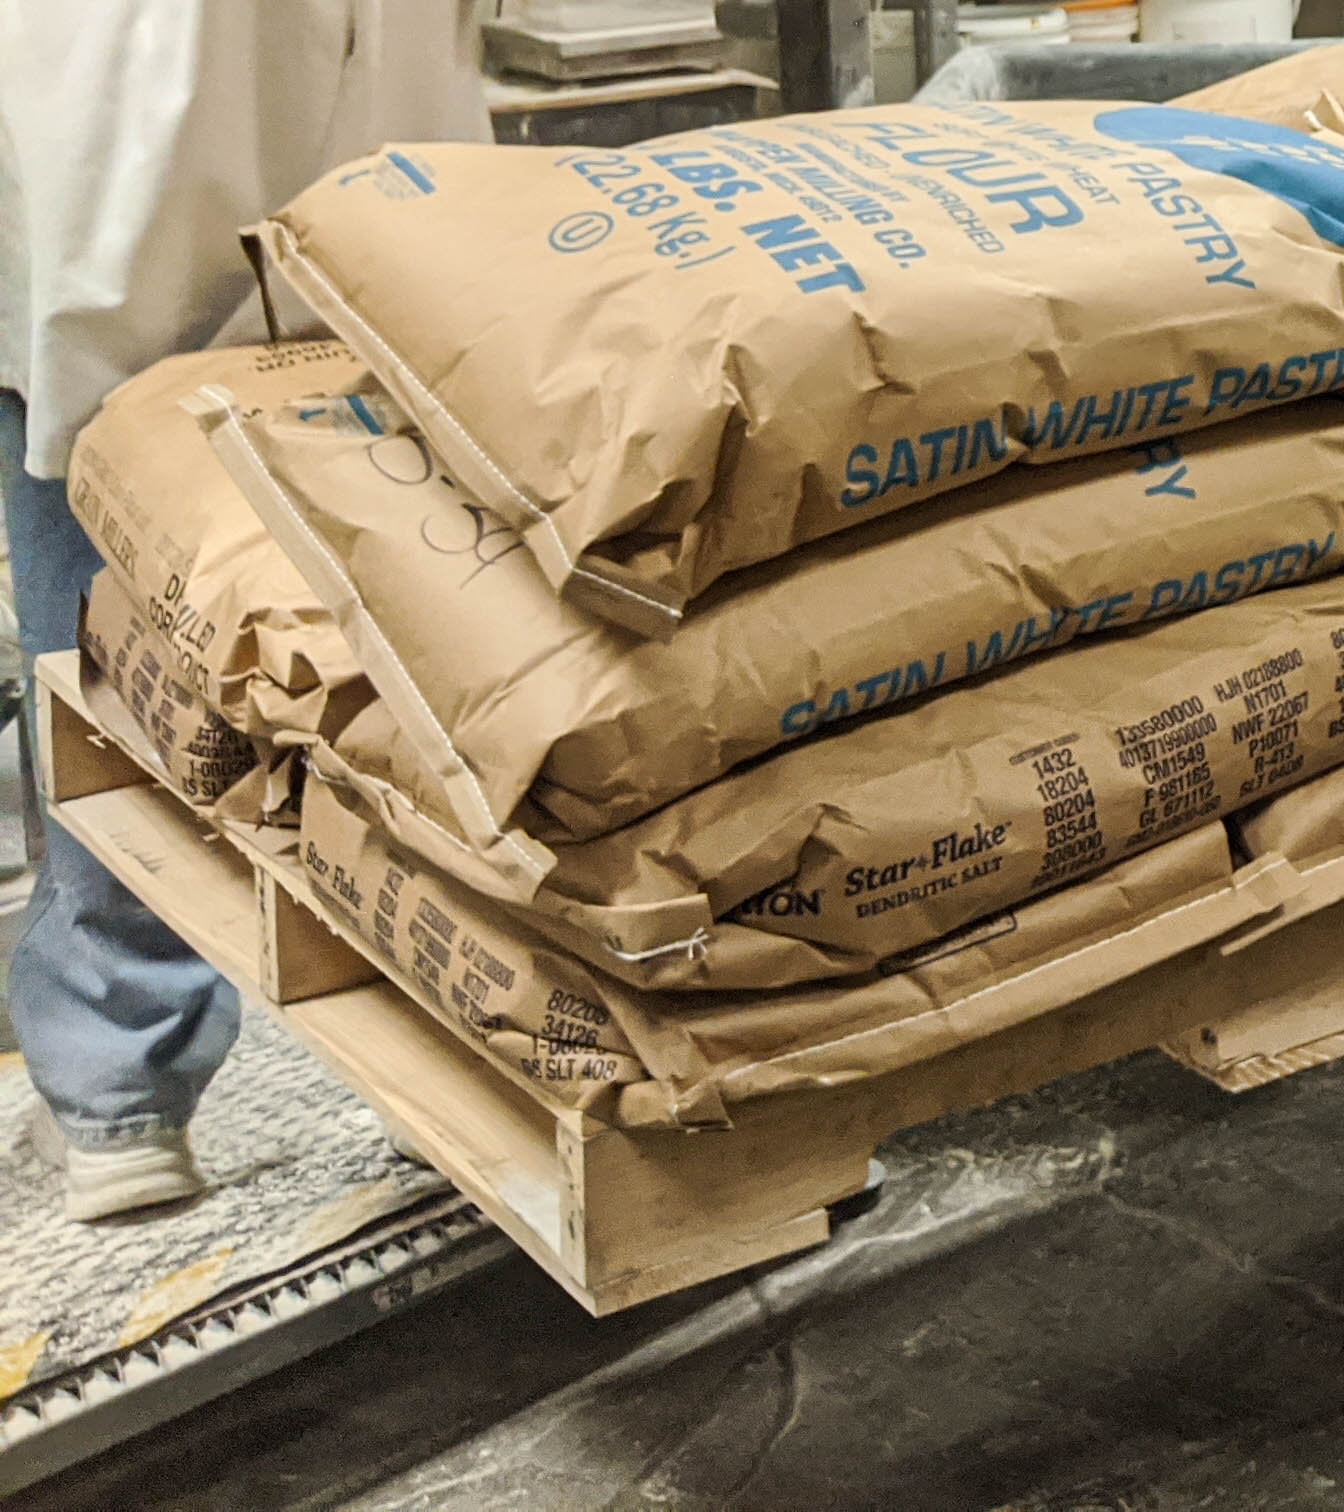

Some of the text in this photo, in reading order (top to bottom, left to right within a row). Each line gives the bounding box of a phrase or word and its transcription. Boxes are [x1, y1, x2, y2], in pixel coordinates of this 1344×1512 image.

[554, 150, 681, 218] (22.68
[831, 122, 1084, 234] FLOUR
[650, 150, 764, 213] LBS.
[739, 214, 867, 294] NET
[1111, 160, 1256, 289] PASTRY
[873, 227, 927, 269] CO.
[838, 402, 1009, 510] SATIN
[1021, 374, 1195, 450] WHITE
[780, 650, 946, 736] SATIN
[1147, 533, 1335, 616] PASTRY
[1243, 679, 1288, 714] N1701
[1231, 713, 1266, 745] NWF
[1032, 747, 1077, 780] 1432
[1036, 766, 1089, 802] 18204
[1142, 742, 1206, 786] CM1549
[844, 857, 917, 898] Star
[930, 822, 1006, 870] Flake
[960, 856, 1003, 885] SALT
[545, 1058, 576, 1081] SLT
